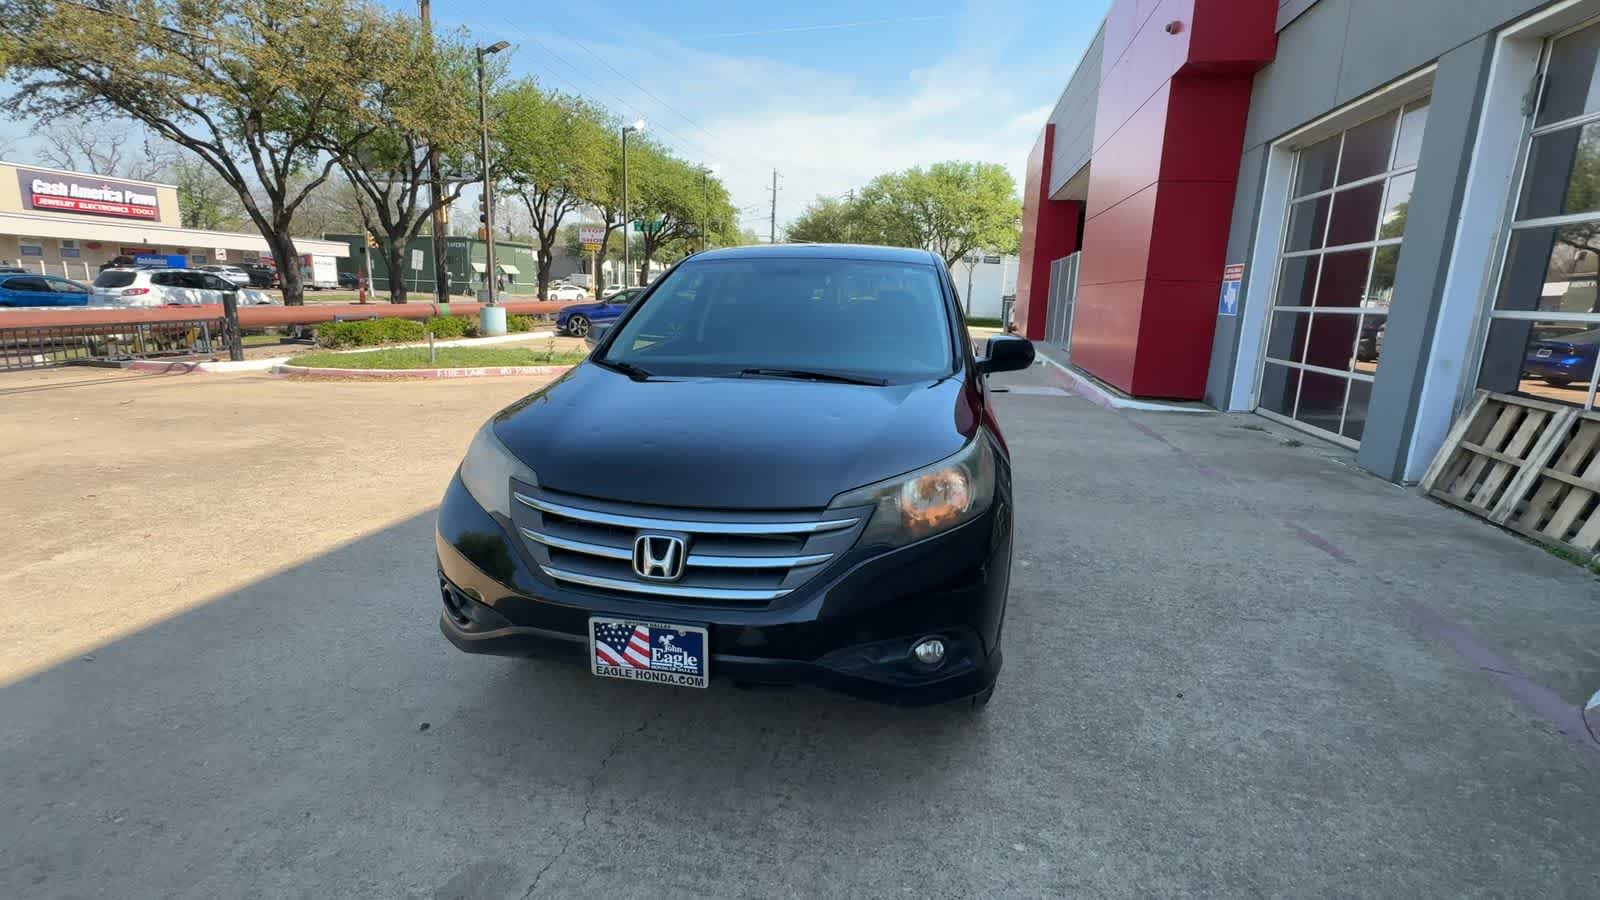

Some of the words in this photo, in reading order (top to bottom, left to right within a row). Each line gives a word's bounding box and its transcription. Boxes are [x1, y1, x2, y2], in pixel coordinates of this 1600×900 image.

[32, 179, 68, 196] Cash
[70, 184, 122, 202] America
[125, 190, 156, 206] Pawn
[38, 198, 75, 208] JEWELRY
[79, 202, 129, 213] ELECTRONICS
[132, 207, 154, 216] TOOLS
[651, 647, 698, 669] Eagle
[664, 644, 683, 653] John
[596, 666, 632, 678] EAGLE
[635, 669, 704, 687] HONDA.COM
